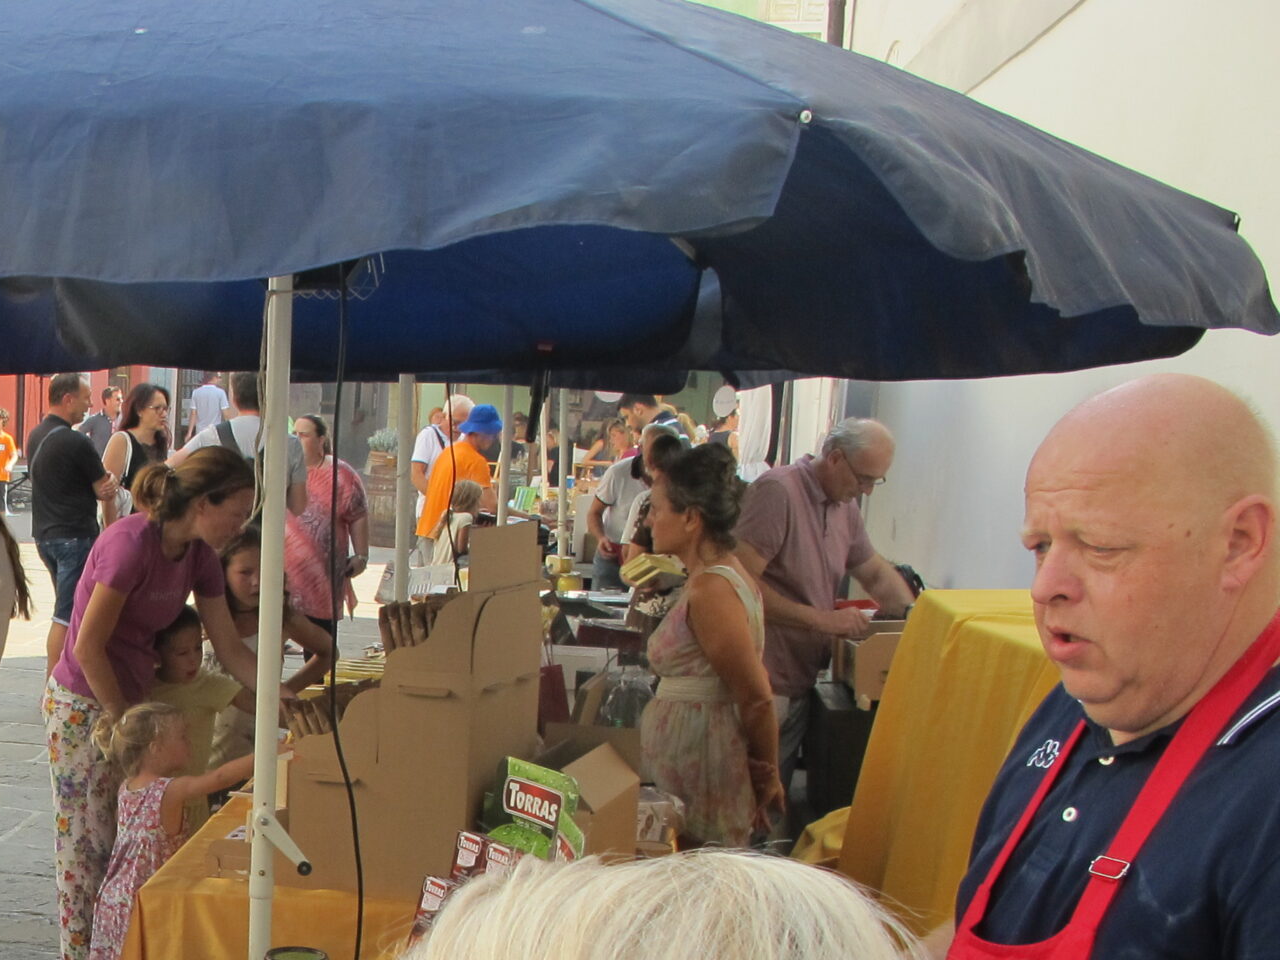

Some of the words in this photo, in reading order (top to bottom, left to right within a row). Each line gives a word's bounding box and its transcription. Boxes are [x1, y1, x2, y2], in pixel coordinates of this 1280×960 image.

[509, 782, 558, 822] TORRAS
[460, 836, 480, 853] TORRAS
[426, 881, 445, 898] TORRAS
